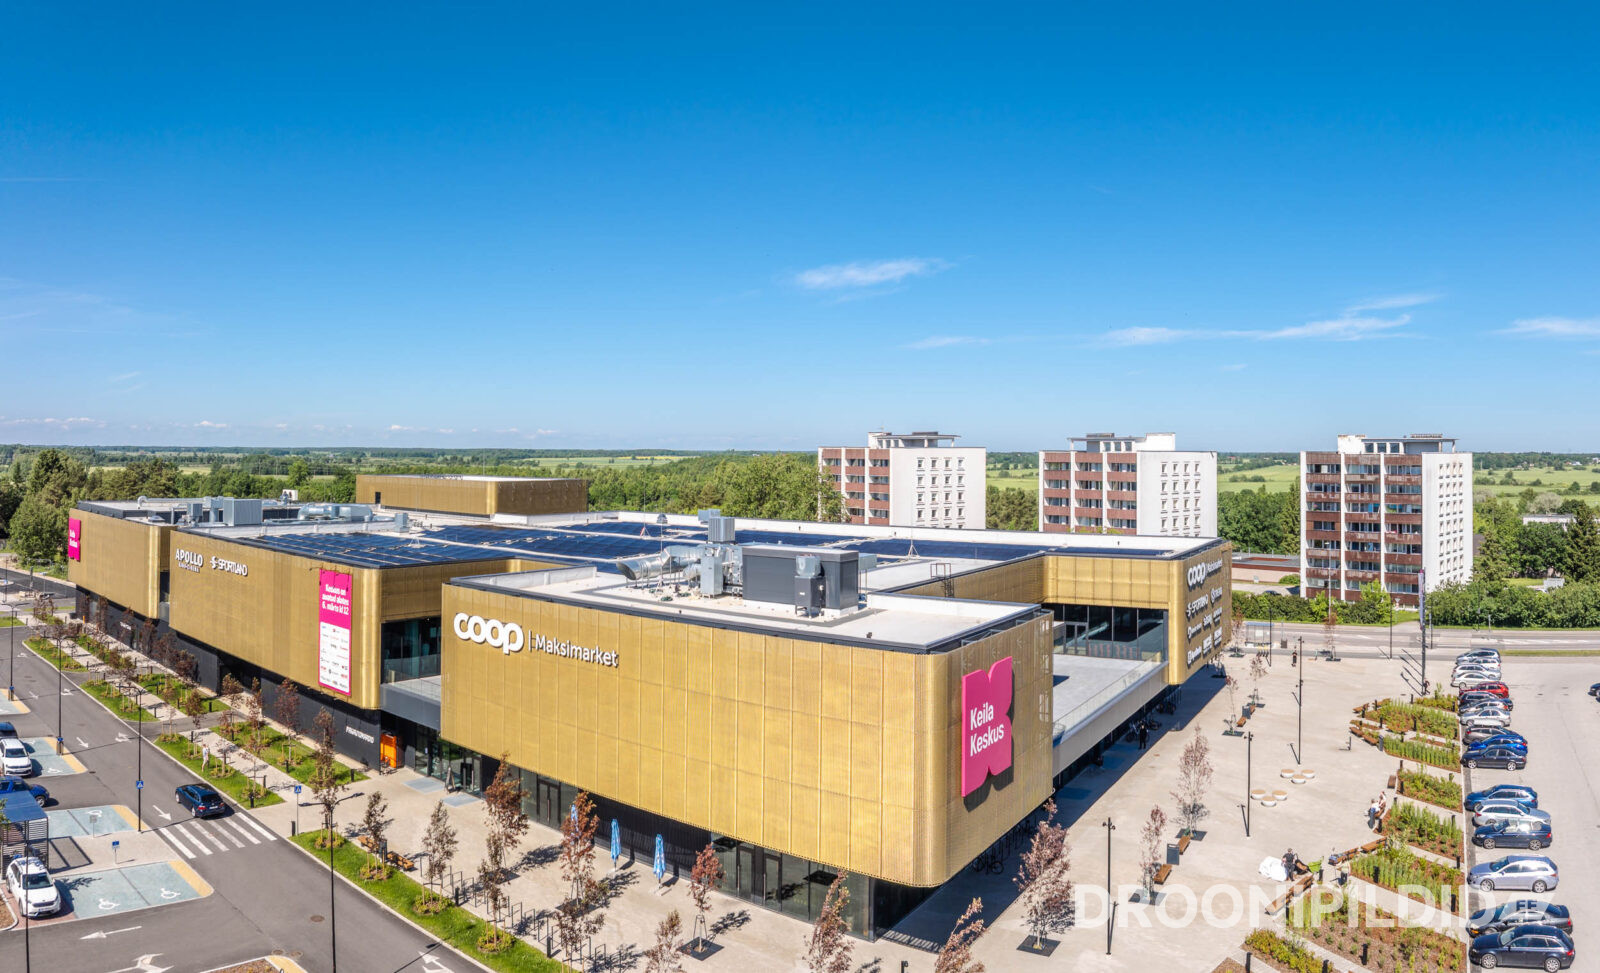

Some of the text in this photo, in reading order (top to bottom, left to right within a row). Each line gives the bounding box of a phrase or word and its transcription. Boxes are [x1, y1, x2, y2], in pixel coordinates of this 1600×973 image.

[175, 548, 204, 567] APOLLO
[218, 558, 249, 577] SPORTLAND
[453, 612, 619, 667] coop Maksimarket
[970, 701, 994, 731] Keila
[970, 723, 1005, 757] Keskus
